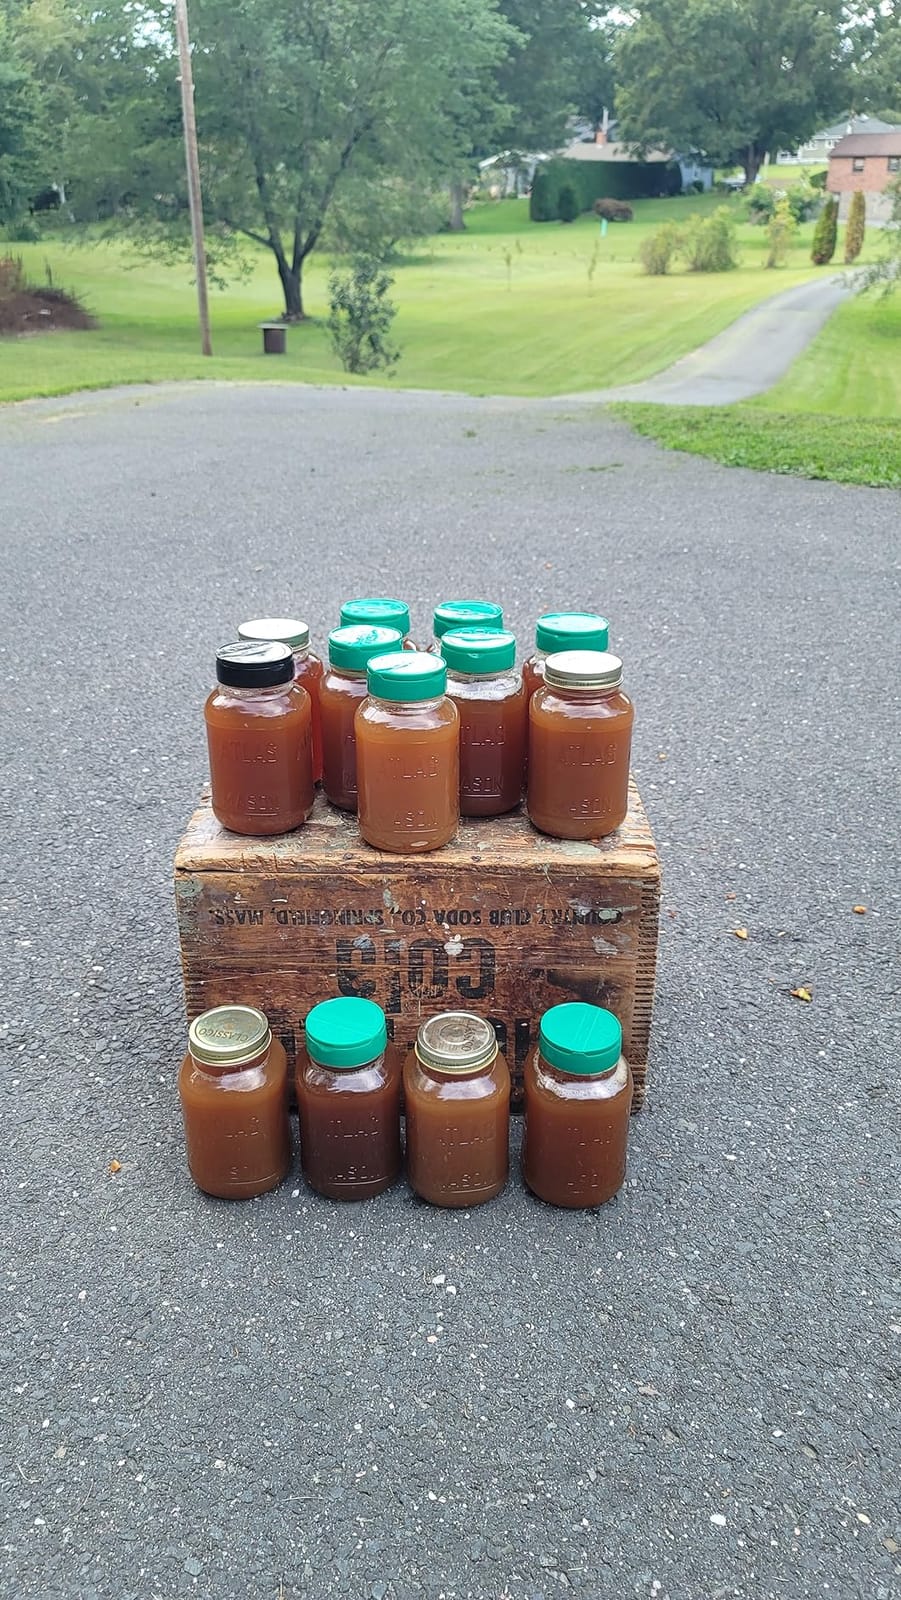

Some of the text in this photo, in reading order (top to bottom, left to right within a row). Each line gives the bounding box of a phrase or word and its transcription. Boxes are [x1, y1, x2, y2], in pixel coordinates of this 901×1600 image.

[460, 726, 506, 746] TLAS
[559, 744, 617, 766] TLAS
[380, 756, 439, 778] TLAS
[461, 777, 504, 793] ASON
[562, 798, 613, 814] SON
[384, 812, 438, 828] SON
[432, 908, 482, 925] SODA
[489, 908, 531, 925] CLUB
[538, 908, 623, 925] COUNTRY
[198, 1026, 249, 1042] CLASSICO
[320, 1115, 379, 1138] TLAS
